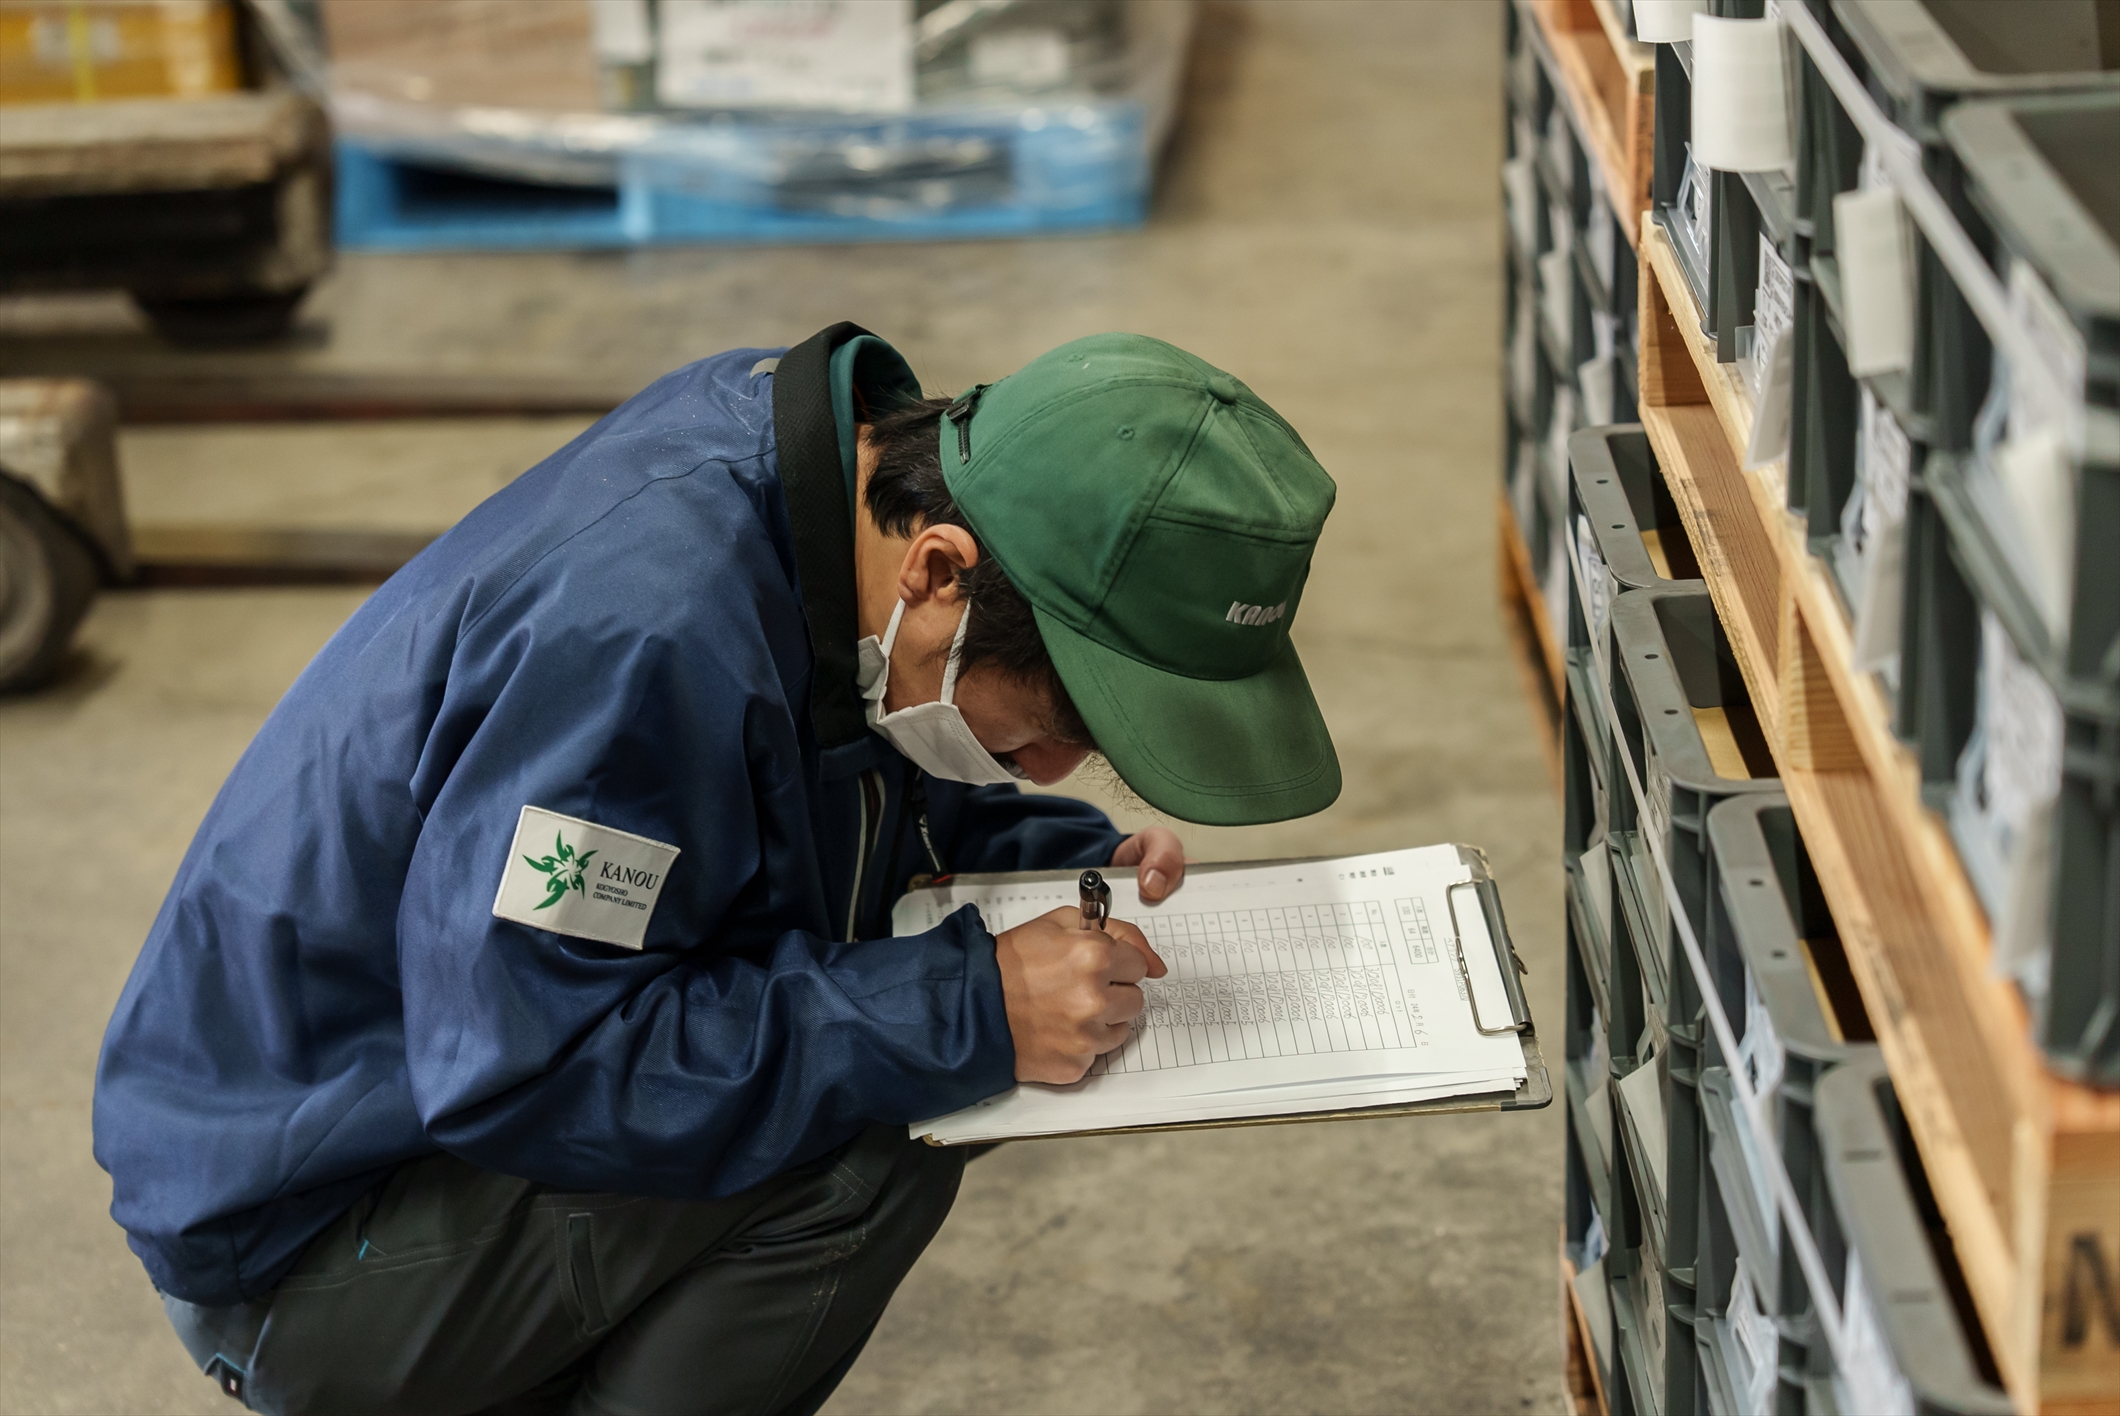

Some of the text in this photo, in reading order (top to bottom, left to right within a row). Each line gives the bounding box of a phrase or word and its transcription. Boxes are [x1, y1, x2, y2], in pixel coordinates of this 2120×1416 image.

[600, 861, 660, 890] KANOU
[593, 892, 648, 911] COMPANY LIMITED
[1401, 905, 1410, 915] 100
[1411, 944, 1422, 958] 6400
[1190, 941, 1206, 955] 100
[1206, 940, 1222, 955] 100
[1220, 939, 1239, 954] 100
[1237, 937, 1257, 953] 100
[1255, 935, 1274, 951] 100
[1273, 936, 1289, 952] 100
[1289, 935, 1306, 949] 100
[1302, 933, 1323, 949] 100
[1320, 933, 1339, 949] 100
[1338, 934, 1356, 949] 100
[1353, 934, 1374, 950] 100
[1157, 943, 1174, 958] 100
[1173, 944, 1190, 958] 100
